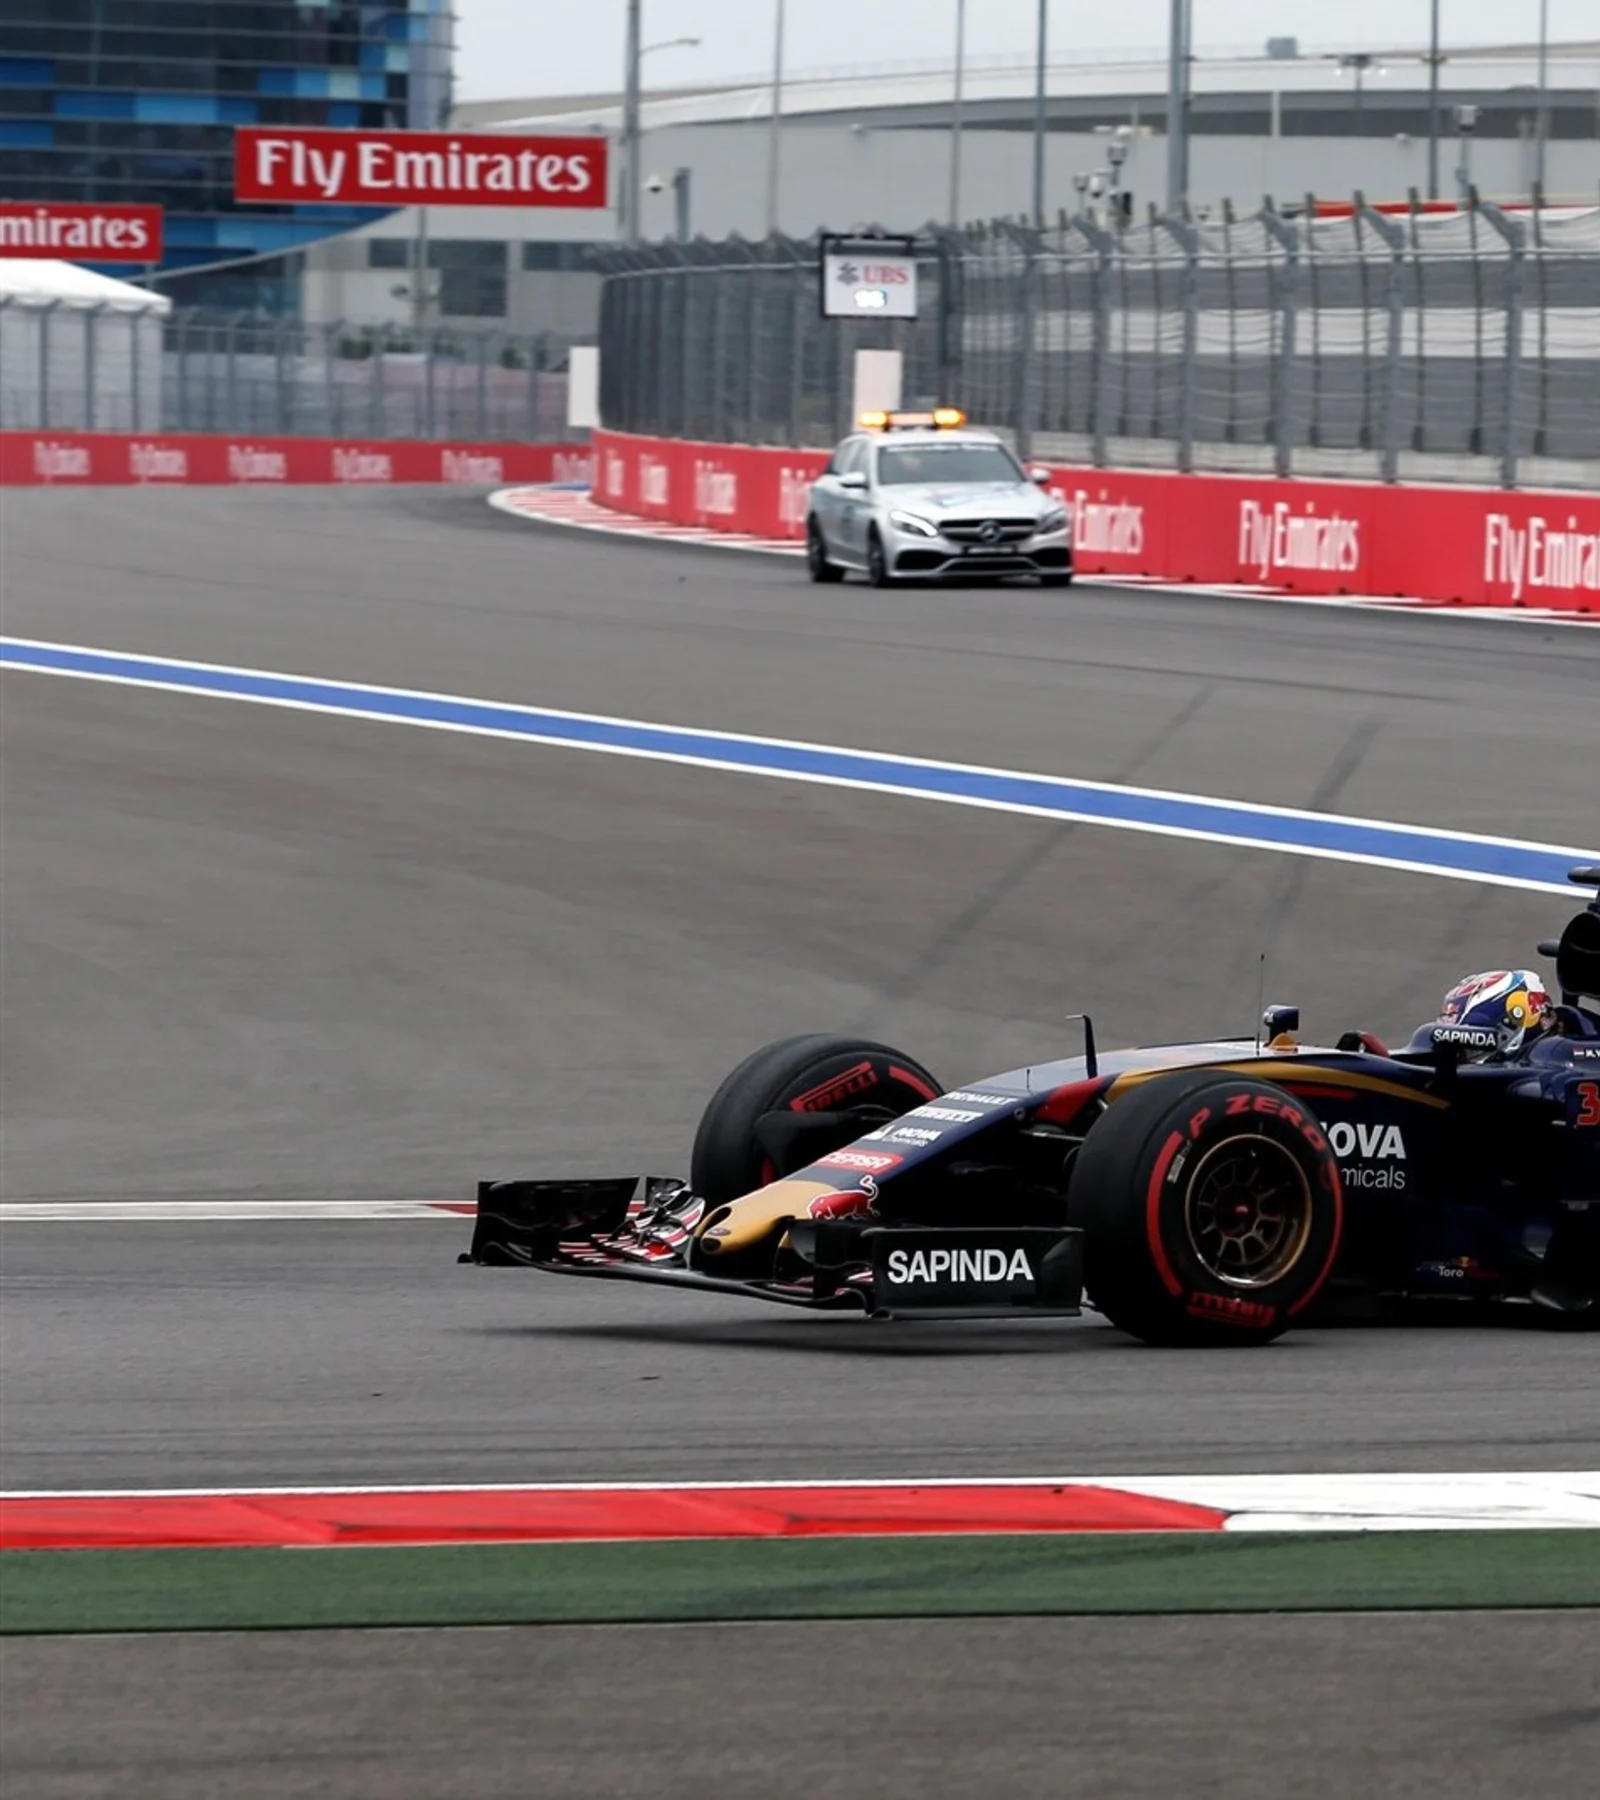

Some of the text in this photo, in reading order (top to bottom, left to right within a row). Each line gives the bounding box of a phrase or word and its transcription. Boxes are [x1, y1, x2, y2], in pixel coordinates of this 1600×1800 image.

[256, 138, 591, 197] Fly Emirates
[863, 265, 909, 285] UBS
[1239, 500, 1359, 580] Fly Emirates
[1484, 513, 1526, 600] Fly
[1433, 1028, 1498, 1047] SAPINDA
[1225, 1094, 1328, 1152] ZERO
[1319, 1120, 1407, 1160] OVA
[888, 1248, 1035, 1284] SAPINDA
